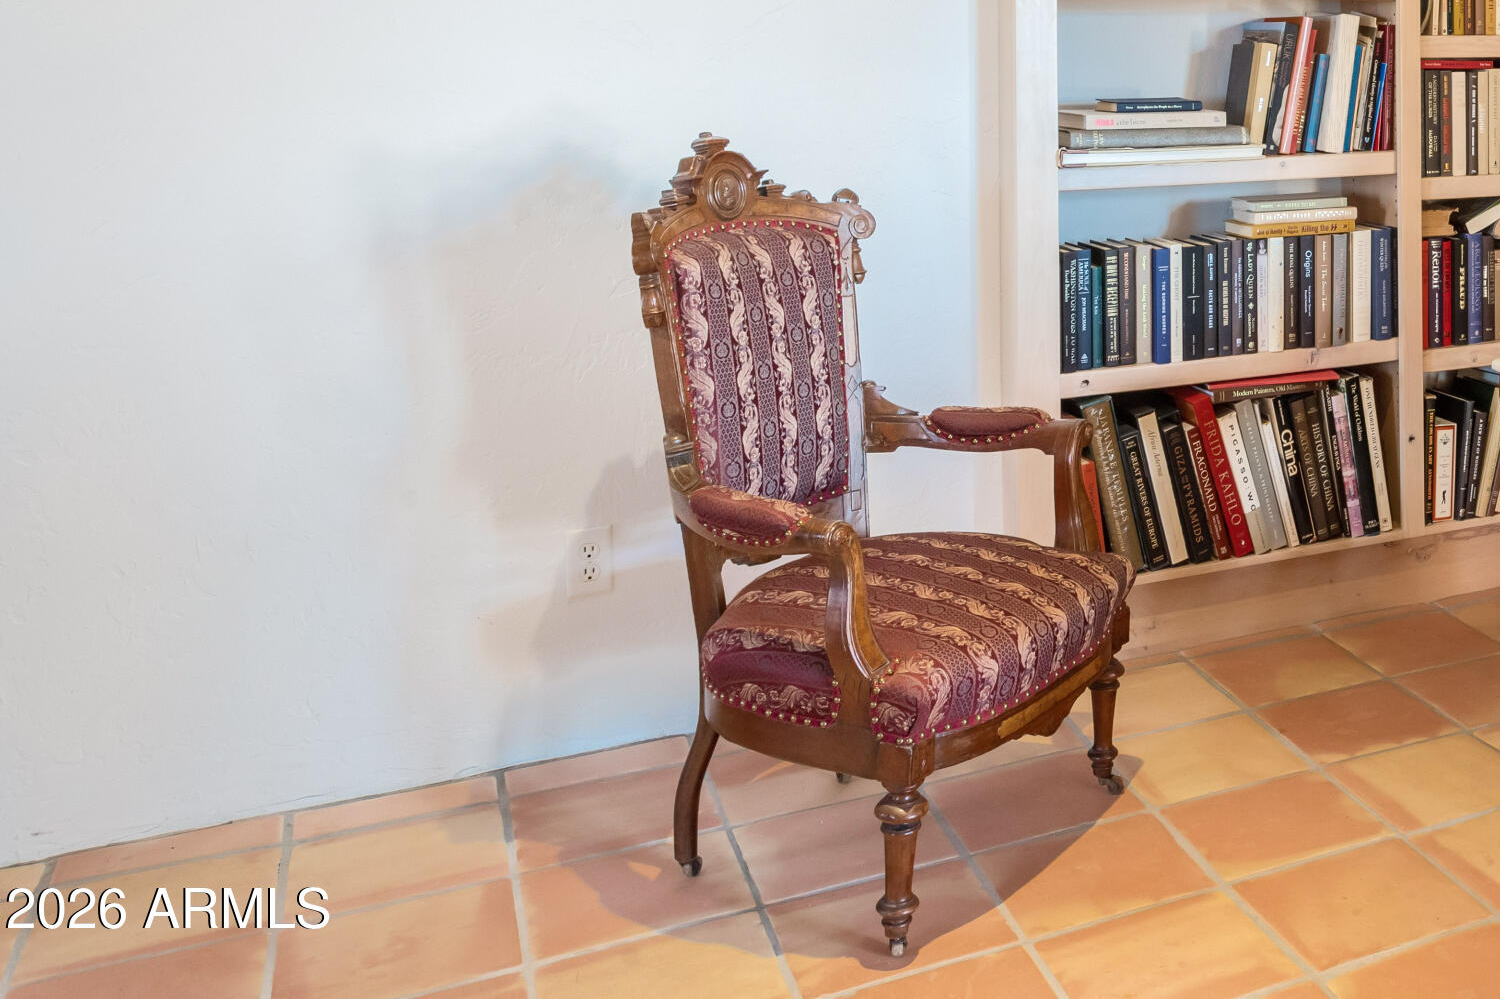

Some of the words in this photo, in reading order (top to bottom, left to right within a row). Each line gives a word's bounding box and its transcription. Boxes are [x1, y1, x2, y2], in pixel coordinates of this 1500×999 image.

[1282, 33, 1295, 60] URUK
[1303, 250, 1313, 278] Origins
[1432, 250, 1441, 290] Renoir
[1280, 429, 1299, 477] China
[1311, 423, 1326, 463] HISTORY
[1130, 451, 1140, 477] GREAT
[1203, 420, 1225, 468] FRIDA
[1219, 470, 1241, 526] KAHLO
[1319, 464, 1330, 477] OF
[1135, 478, 1147, 506] RIVERS
[1323, 479, 1334, 511] CHINA
[1143, 506, 1151, 517] OF
[1146, 518, 1158, 549] EUROPE
